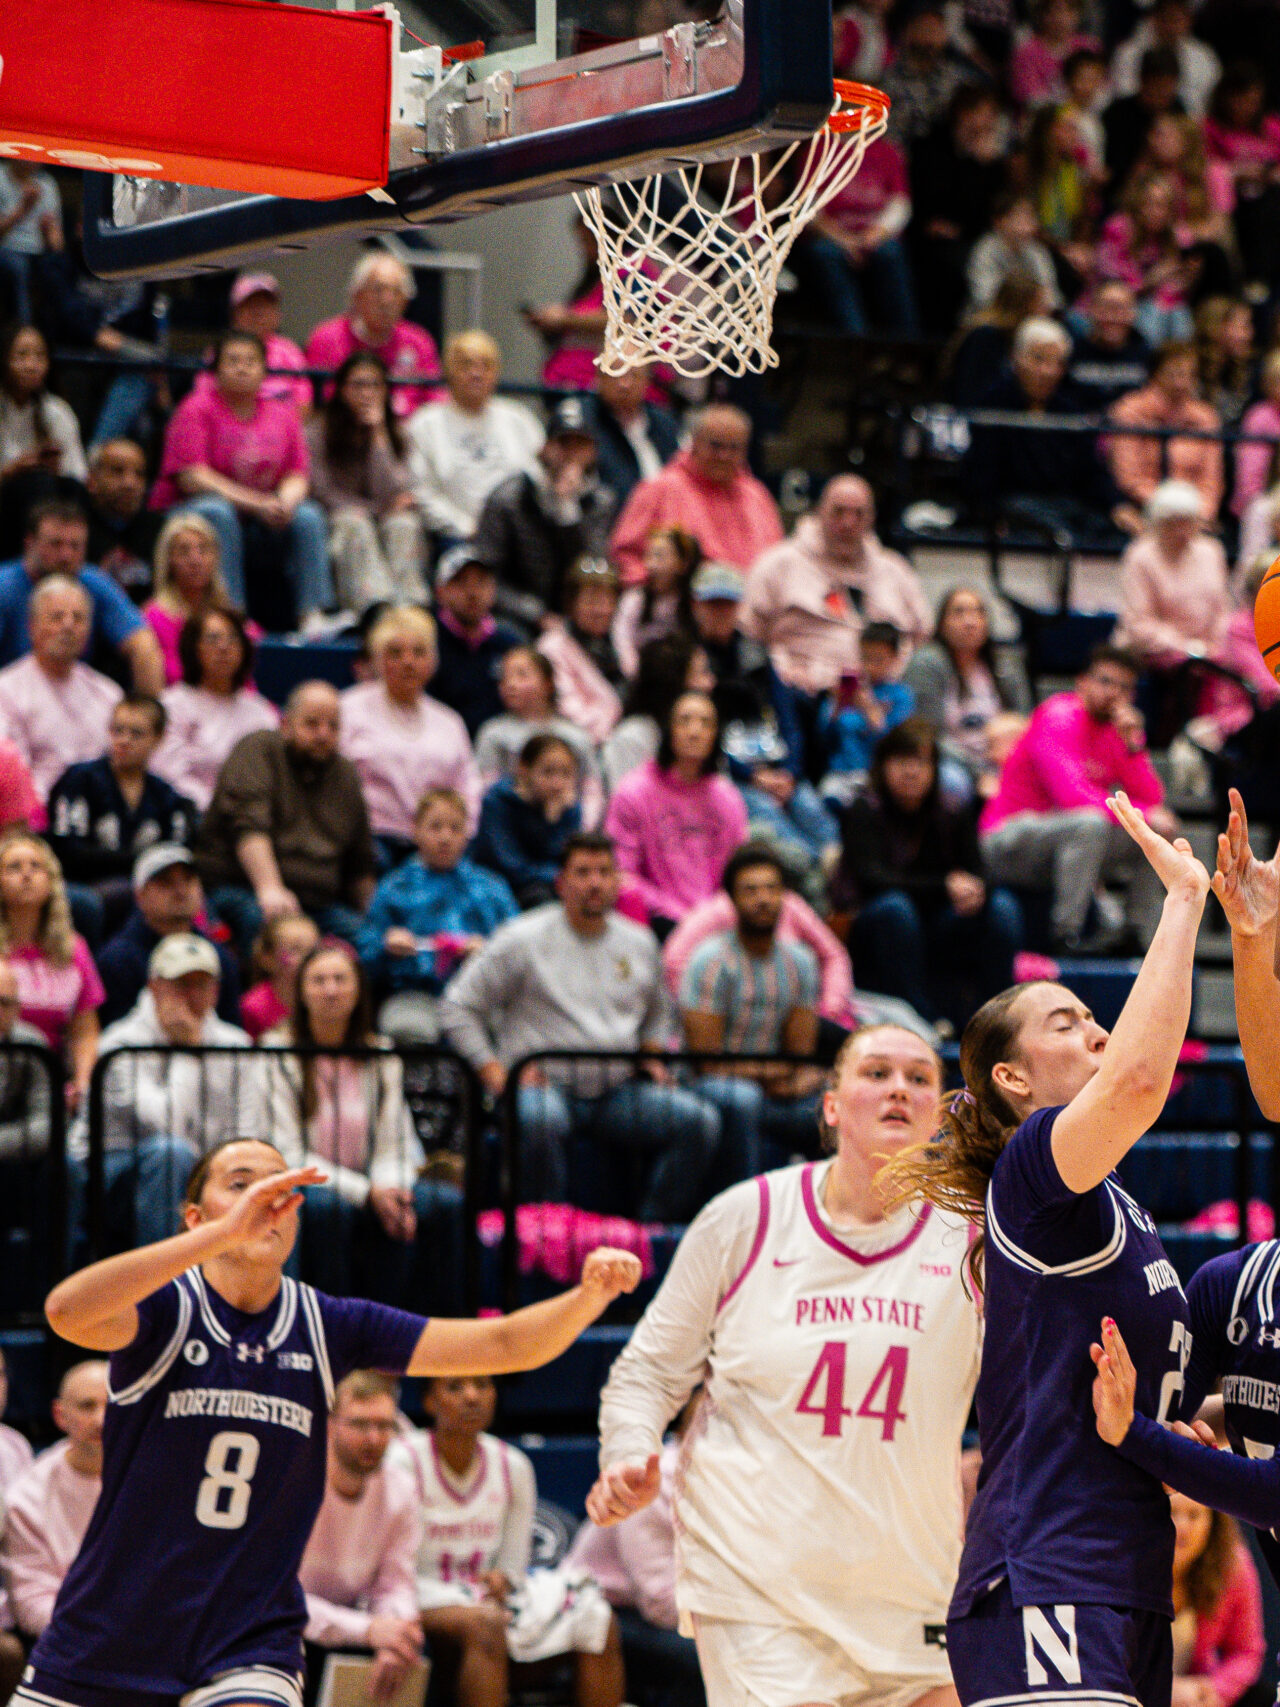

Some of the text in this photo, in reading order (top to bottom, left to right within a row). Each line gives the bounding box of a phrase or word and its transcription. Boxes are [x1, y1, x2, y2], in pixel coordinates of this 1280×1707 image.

[795, 1295, 926, 1334] PENN STATE
[164, 1387, 314, 1440] NORTHWESTERN
[795, 1340, 909, 1442] 44
[195, 1430, 261, 1530] 8
[1022, 1604, 1082, 1686] N
